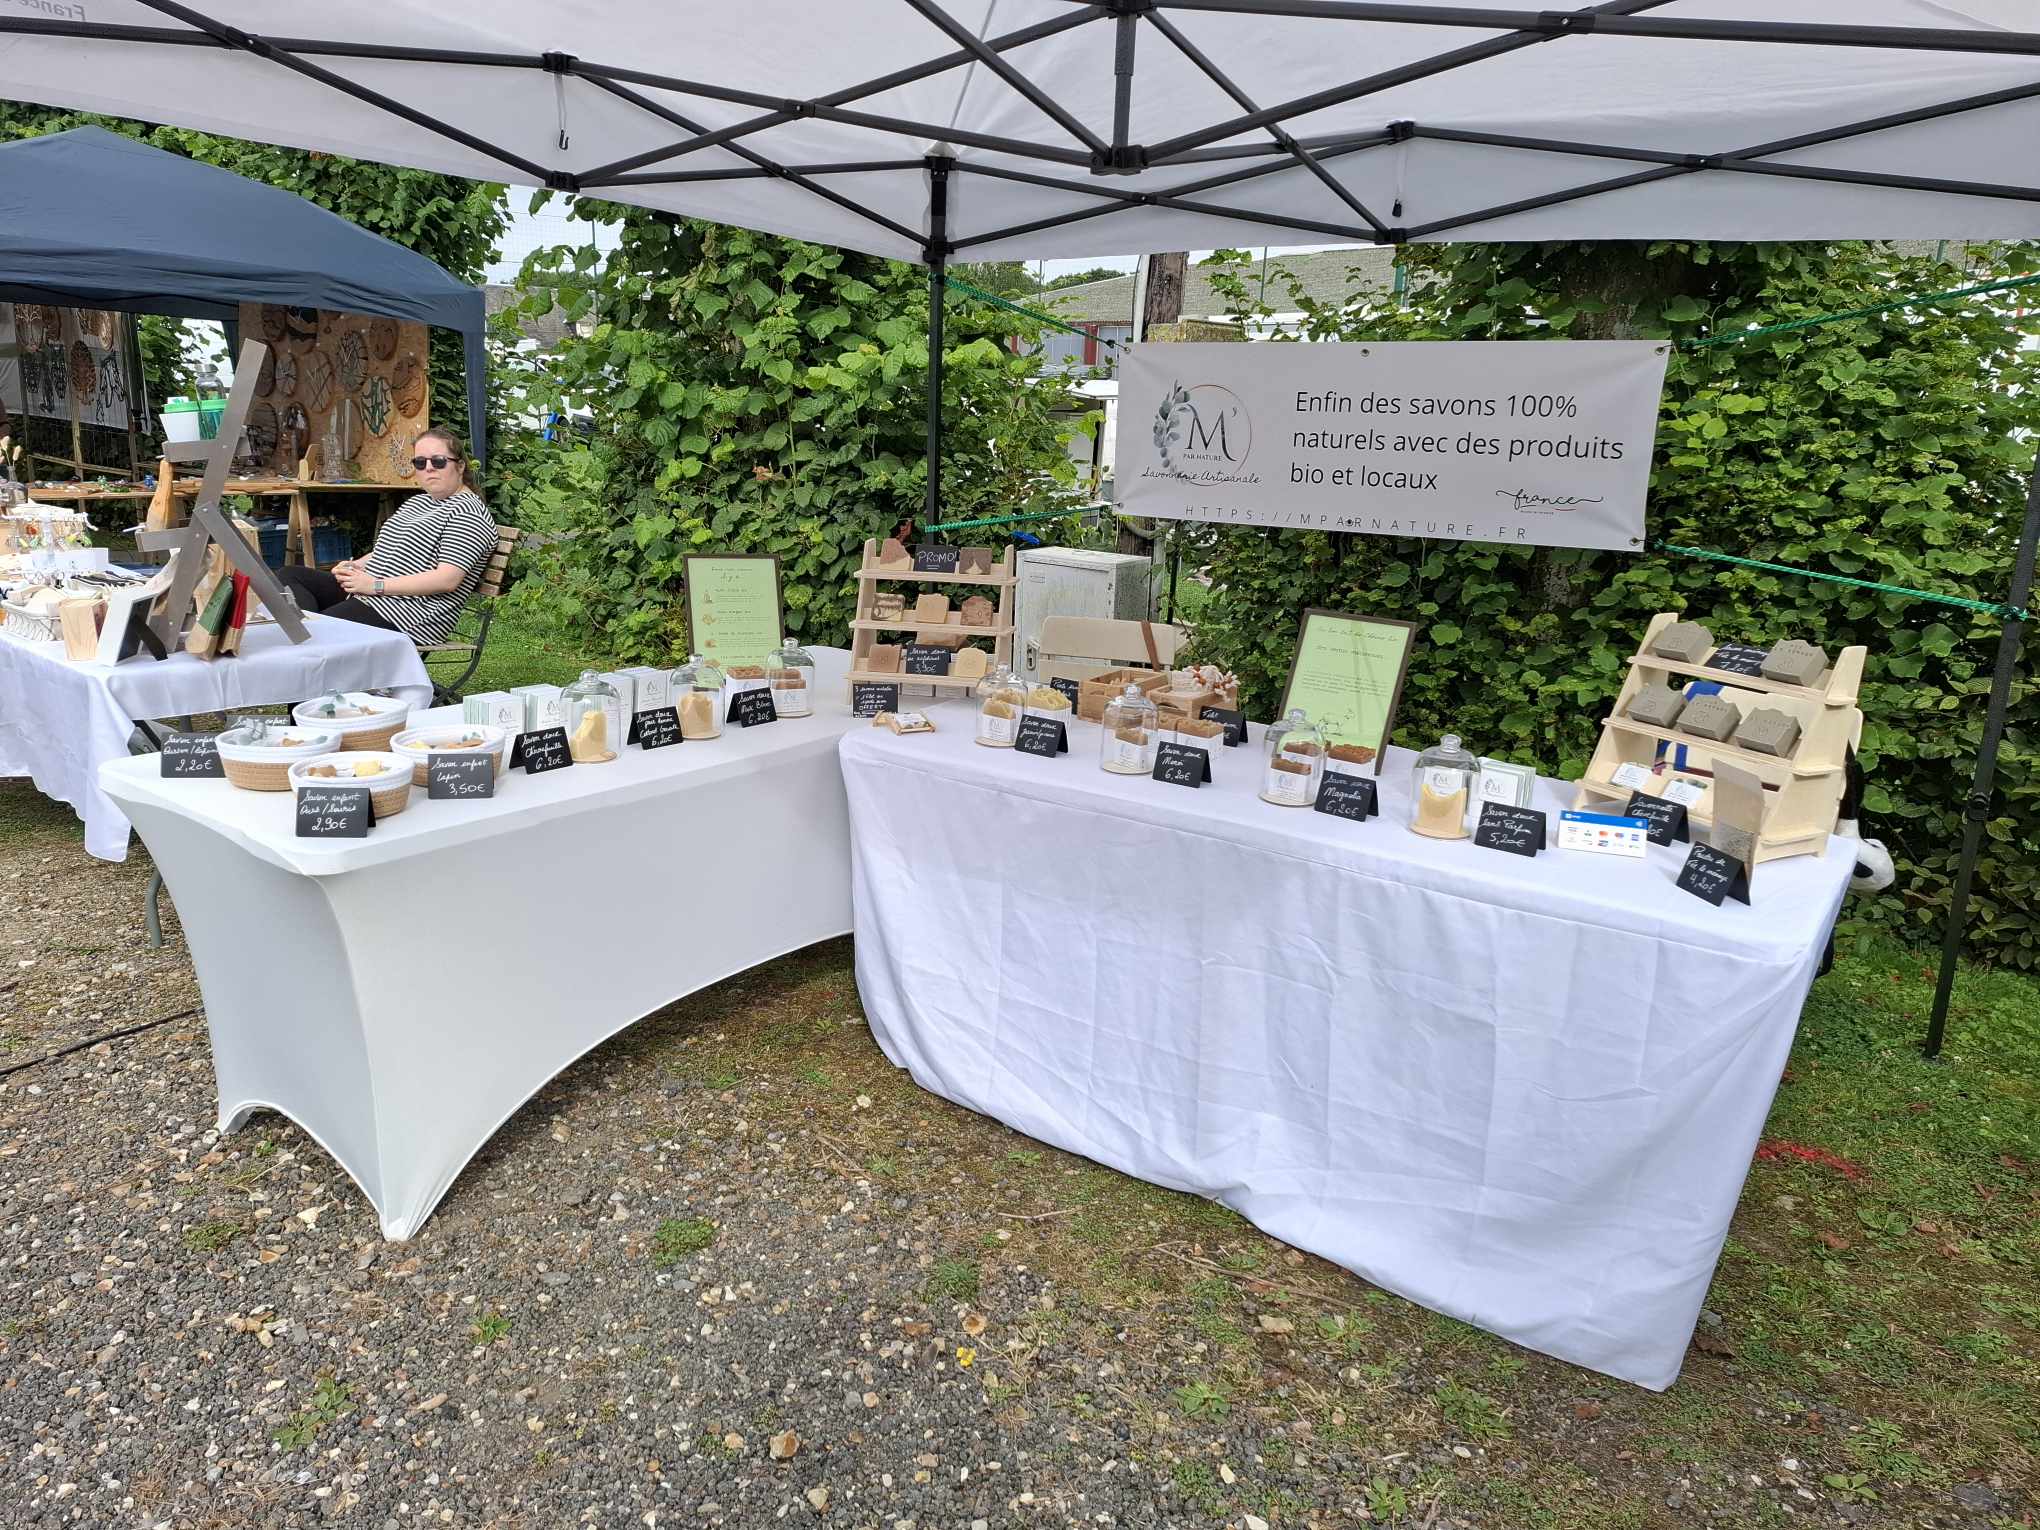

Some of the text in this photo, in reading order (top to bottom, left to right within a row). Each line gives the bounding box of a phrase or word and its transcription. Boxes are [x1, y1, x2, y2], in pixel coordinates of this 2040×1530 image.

[1295, 390, 1578, 418] Enfin des savons 100%
[1293, 429, 1624, 462] naturels avec des produits
[1197, 454, 1222, 462] NATURE
[1290, 462, 1438, 490] bio et locaux
[175, 759, 214, 773] 2,20€
[448, 783, 485, 796] 3,50€
[311, 817, 347, 833] 2,90€
